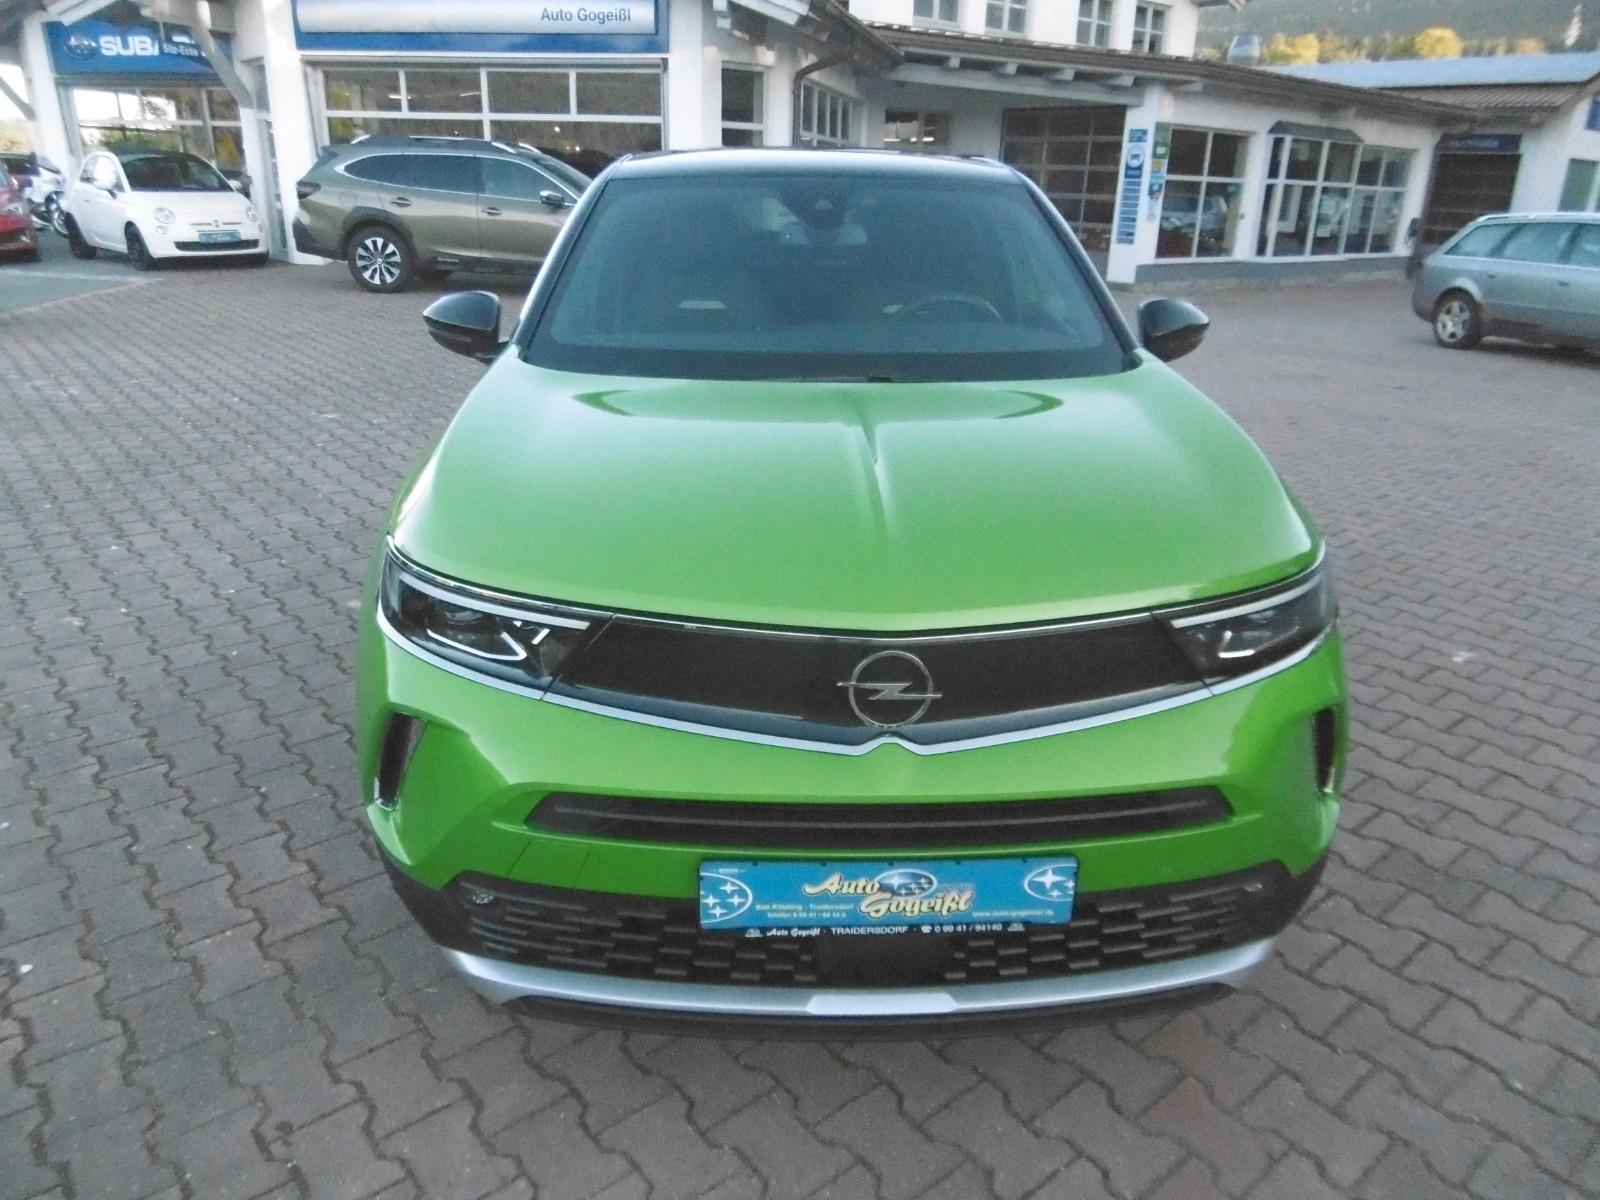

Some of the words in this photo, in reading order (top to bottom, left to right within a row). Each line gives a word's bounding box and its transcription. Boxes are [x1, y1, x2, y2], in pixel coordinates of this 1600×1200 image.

[541, 7, 573, 21] Auto
[577, 7, 631, 25] Gogeißl
[803, 873, 881, 896] Auto
[766, 928, 789, 937] Auto
[831, 925, 909, 936] TRAIDERSDORF
